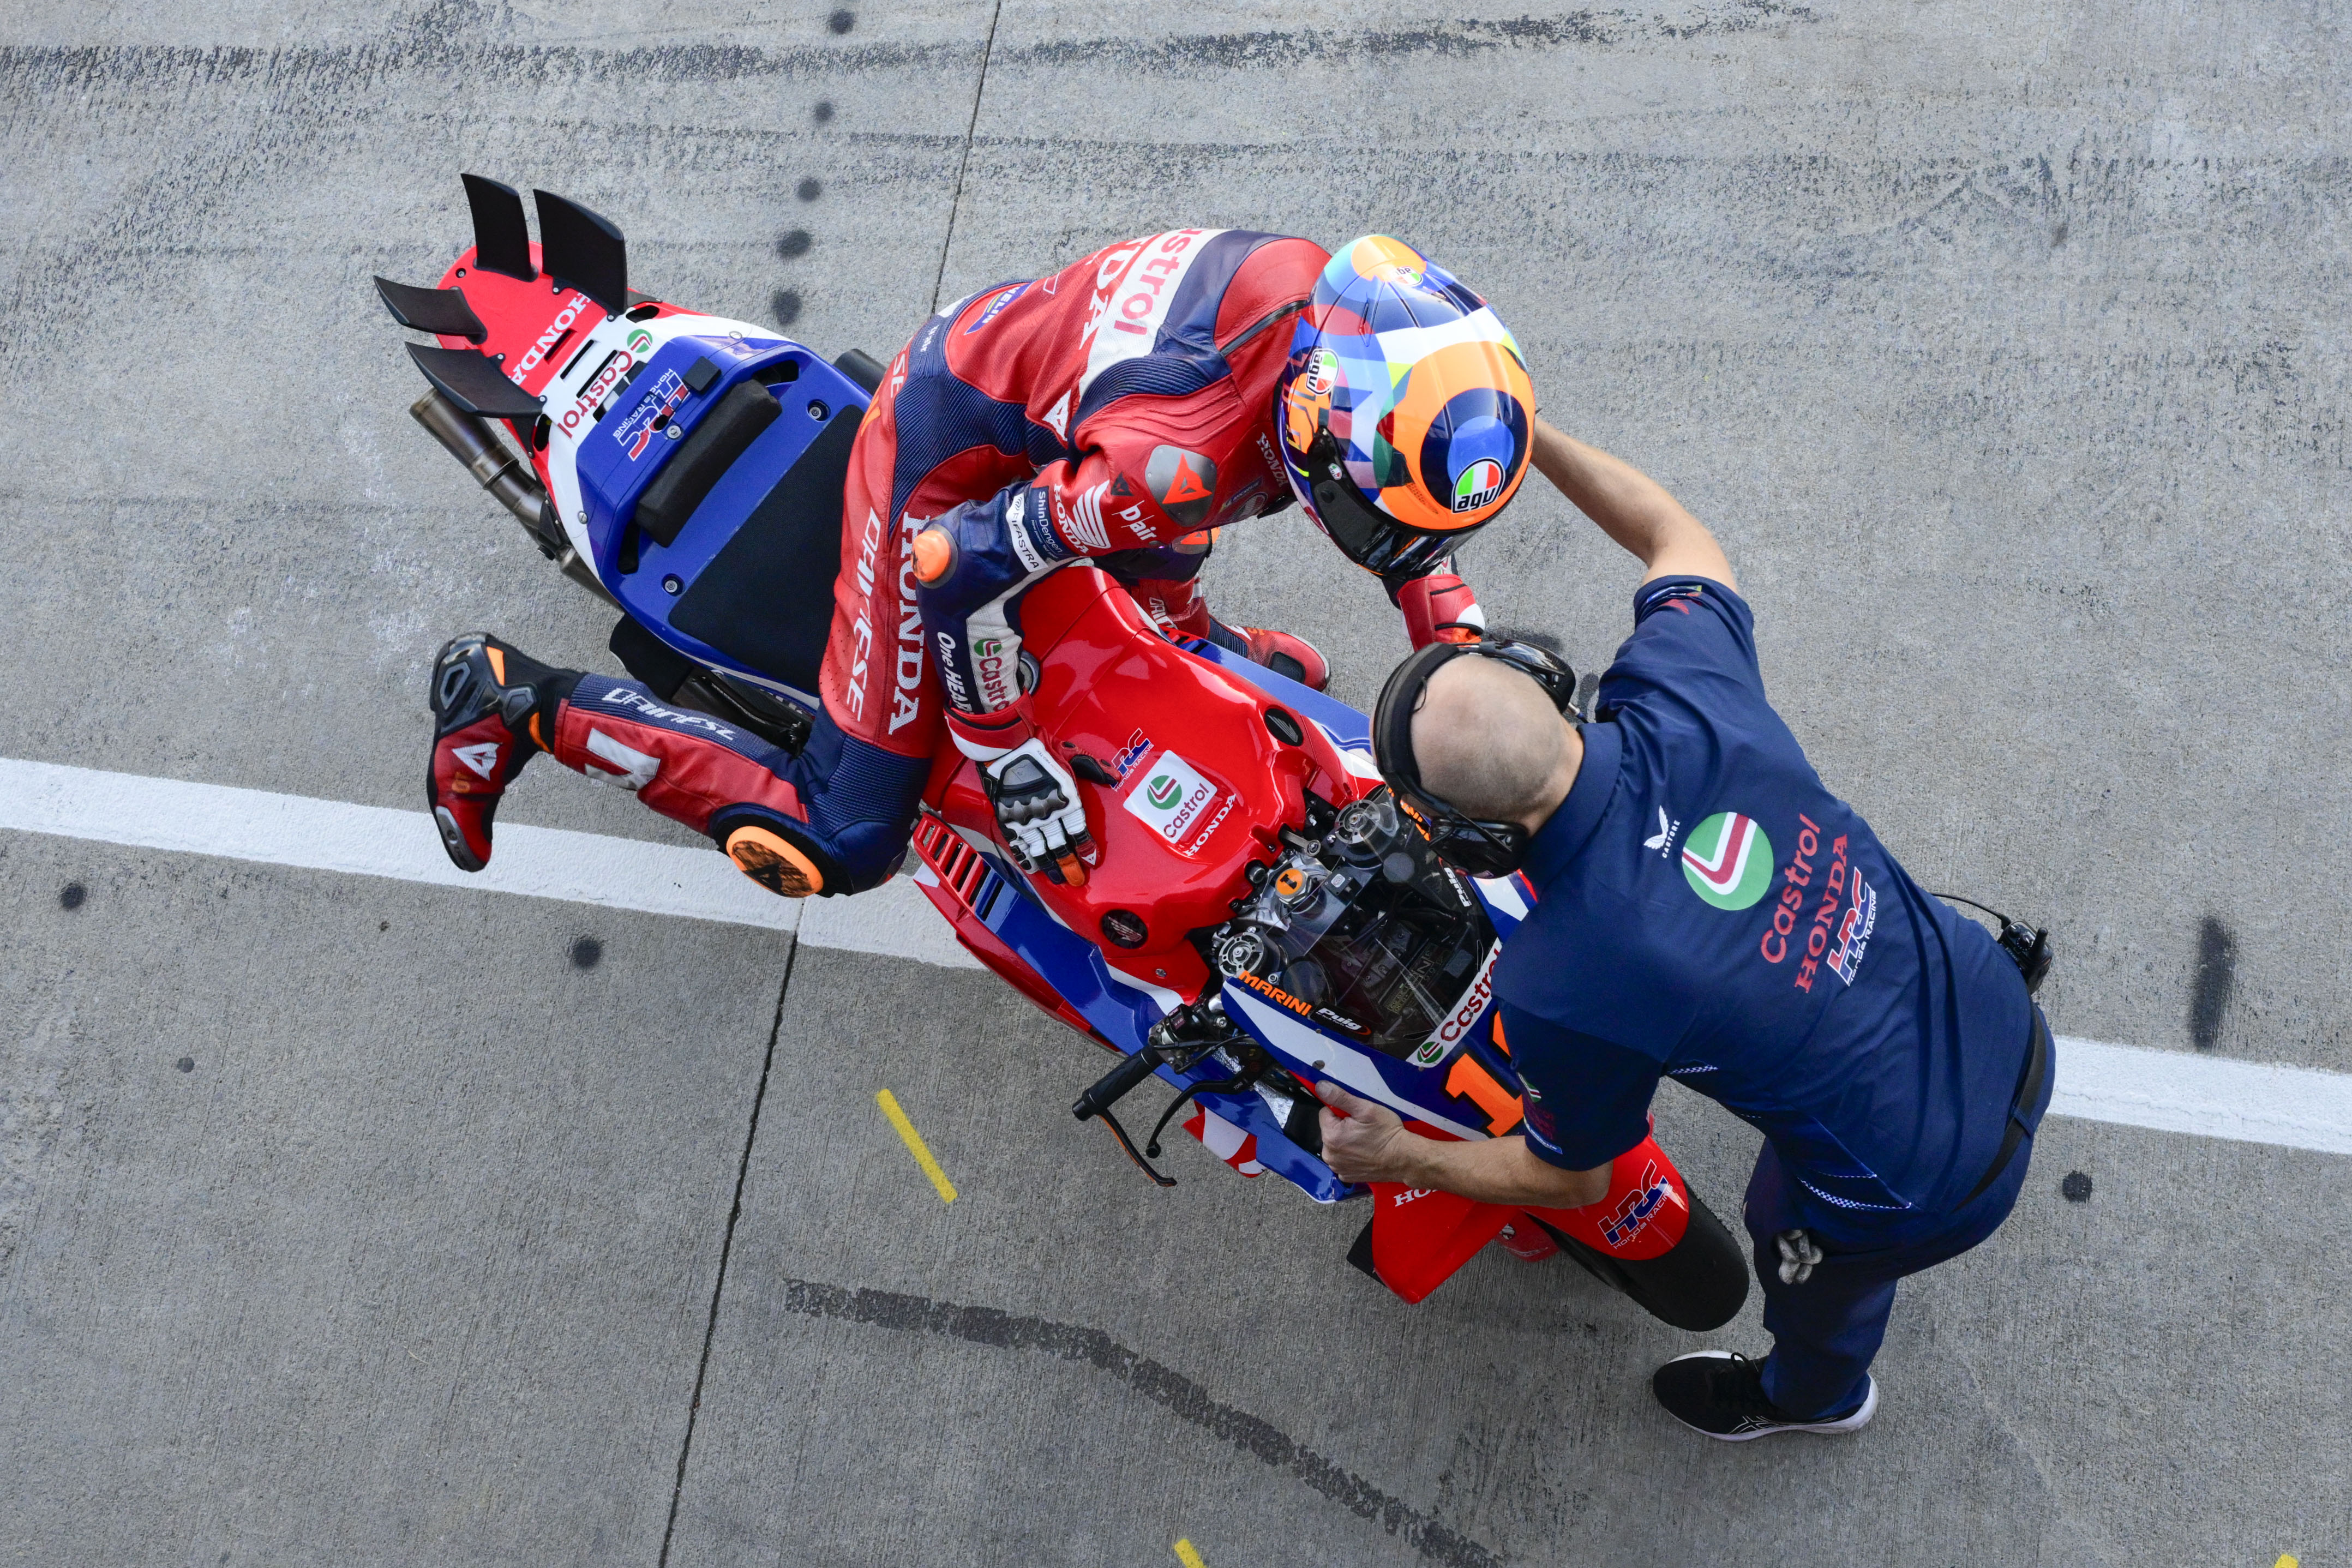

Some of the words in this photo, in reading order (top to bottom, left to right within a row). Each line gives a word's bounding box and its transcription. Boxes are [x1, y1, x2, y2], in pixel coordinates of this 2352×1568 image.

[1114, 229, 1203, 335] strol
[508, 292, 592, 386] HONDA
[557, 351, 633, 439] Castrol
[1309, 353, 1323, 387] agv
[617, 371, 690, 461] HRC
[1256, 431, 1289, 487] HONDA
[1054, 484, 1089, 554] HONDA
[1457, 488, 1496, 510] agv
[937, 632, 956, 667] One
[944, 666, 973, 713] HEAR
[979, 658, 1009, 711] Castro
[1114, 768, 1135, 792] Honda
[1133, 743, 1155, 768] RACING
[1163, 783, 1209, 838] Castrol
[1183, 794, 1236, 857] HONDA
[1661, 820, 1680, 858] CASTORE
[1444, 867, 1470, 907] Puig
[1761, 813, 1820, 963] Castrol
[1795, 834, 1847, 993] HONDA
[1827, 866, 1872, 986] HRC
[1864, 890, 1876, 940] RACING
[1238, 970, 1312, 1016] MARINI
[1317, 1007, 1362, 1030] Puig
[1598, 1158, 1669, 1245] HRC
[1613, 1222, 1647, 1249] Honda
[1646, 1184, 1673, 1221] RACING
